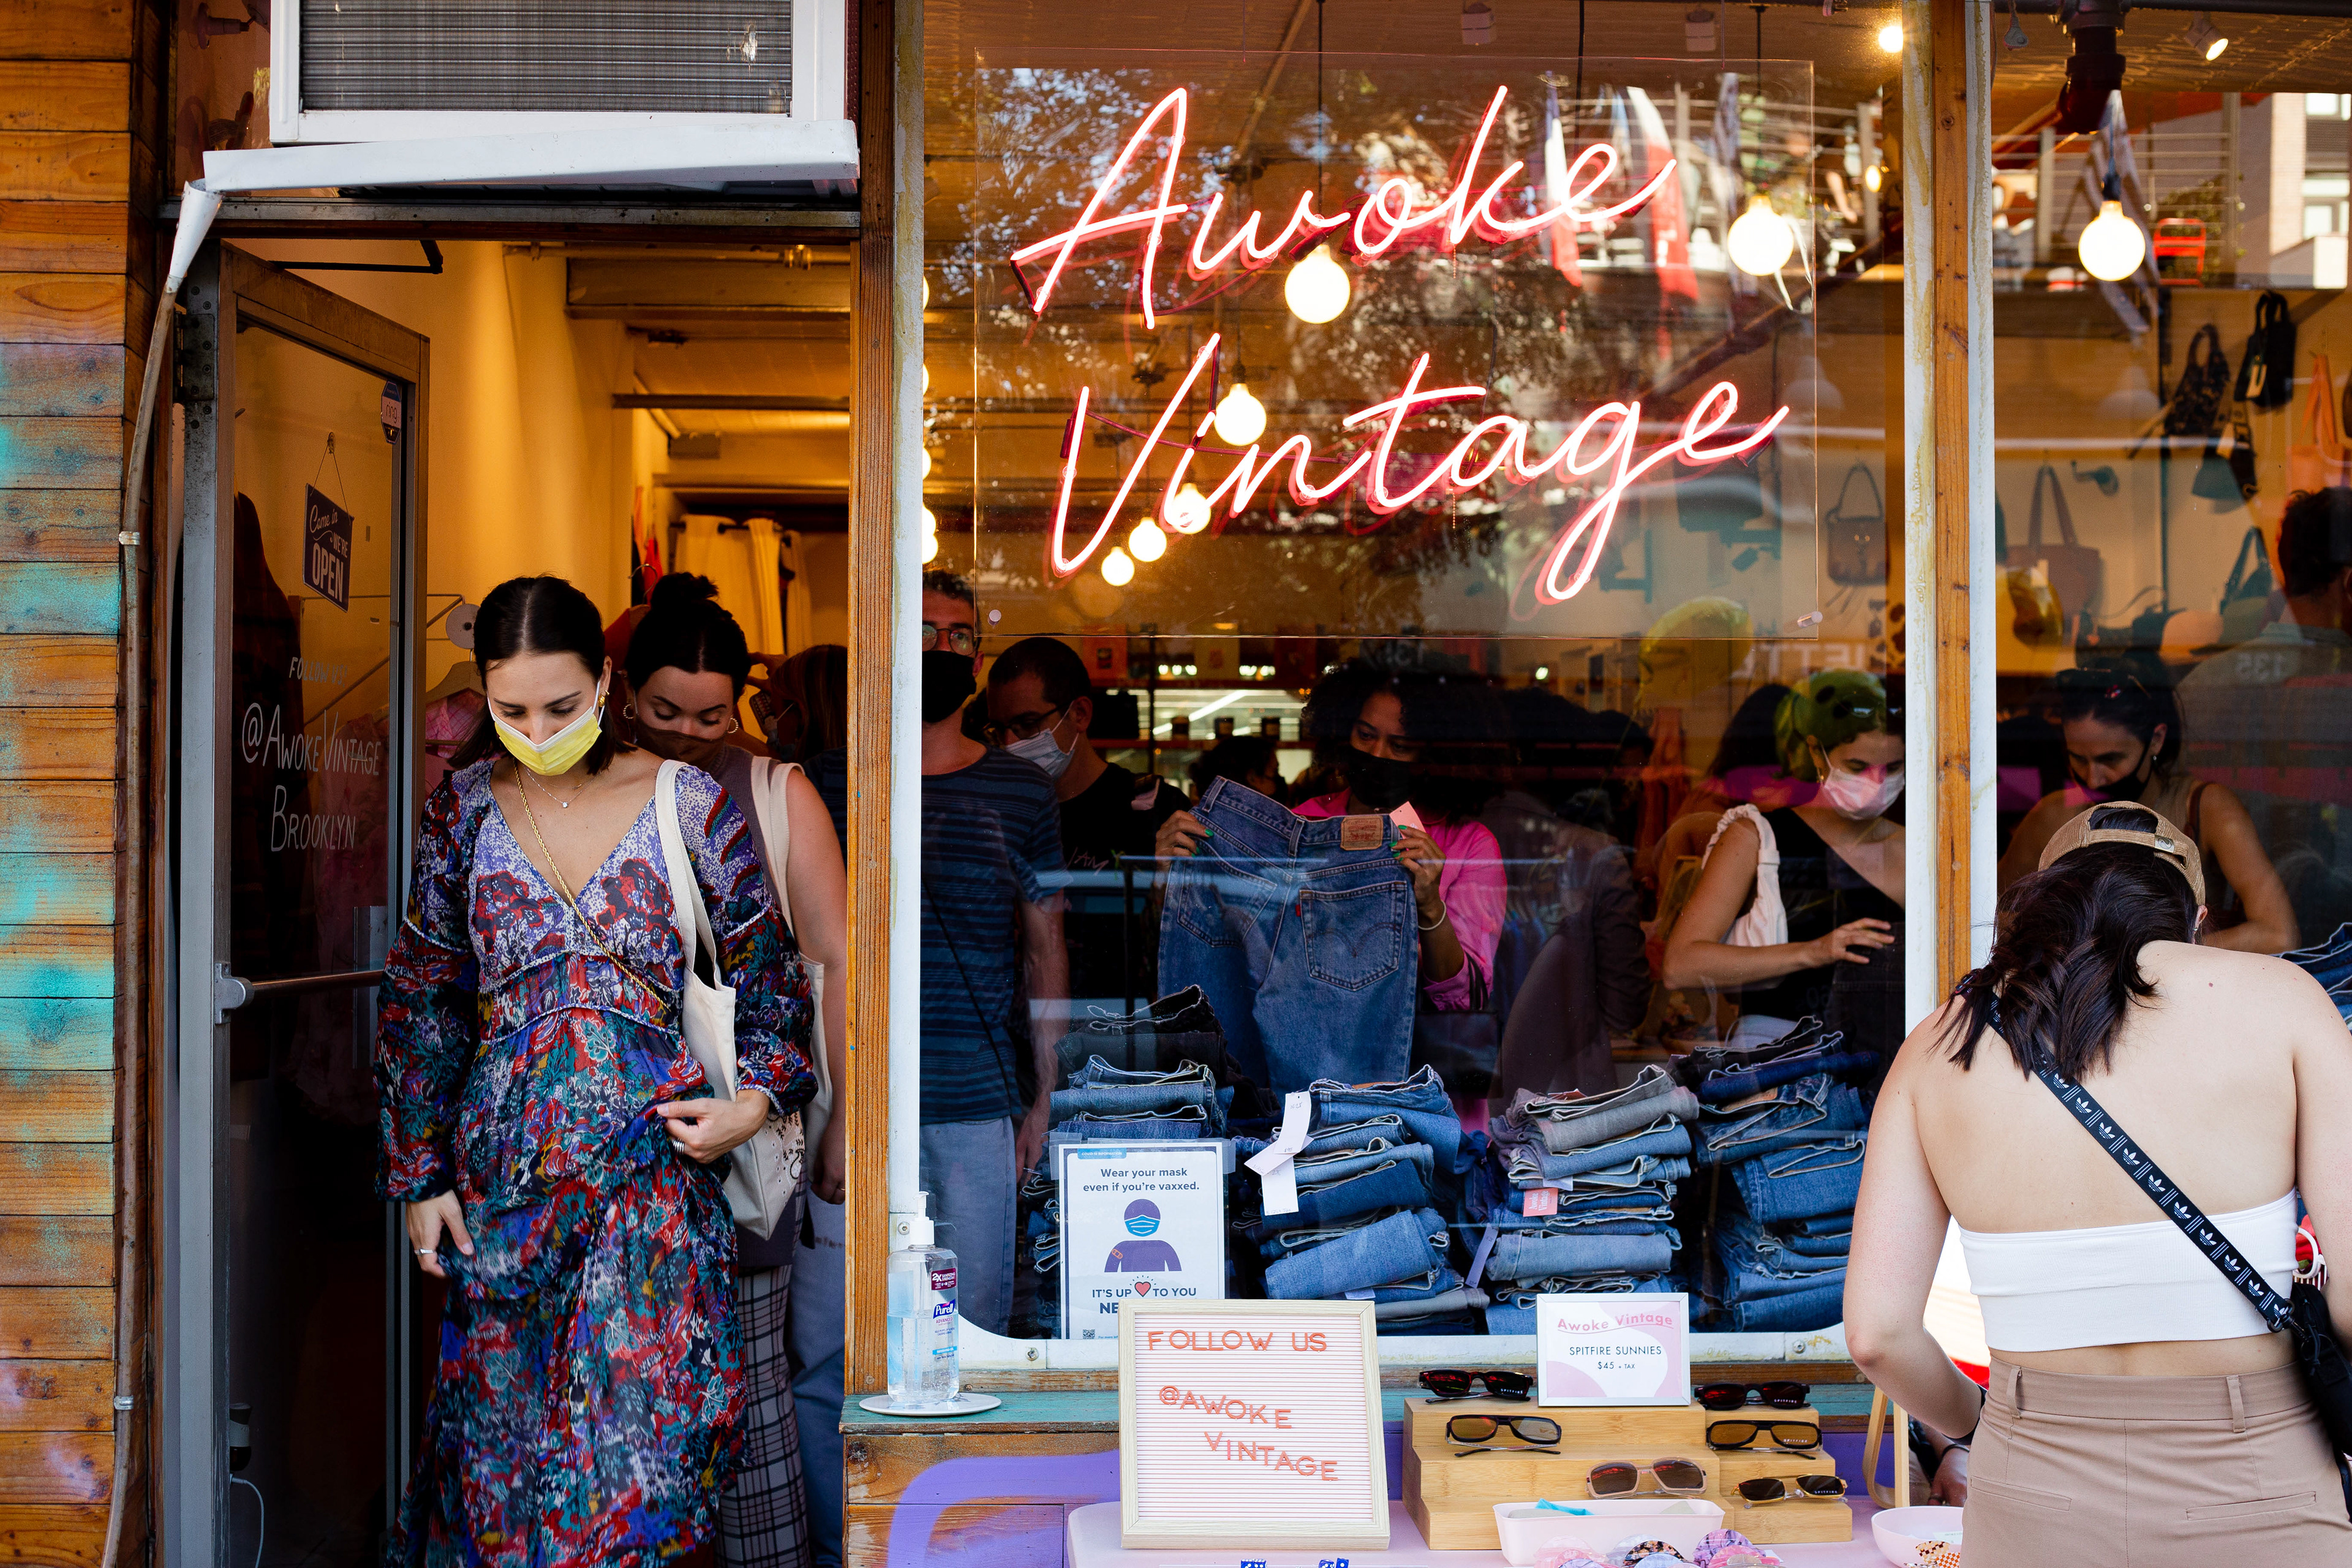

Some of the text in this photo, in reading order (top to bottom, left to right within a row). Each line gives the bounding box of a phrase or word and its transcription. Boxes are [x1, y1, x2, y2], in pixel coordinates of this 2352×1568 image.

[1011, 85, 1677, 330] Awoke
[386, 401, 398, 424] ring
[1050, 333, 1790, 602] Vintage
[309, 504, 338, 533] Come in
[333, 531, 349, 559] WE'RE
[312, 541, 344, 603] OPEN
[289, 657, 328, 684] FOLLOW
[271, 785, 356, 853] BROOKLYN
[1101, 1167, 1188, 1180] Wear your mask
[1112, 1182, 1120, 1191] if
[1121, 1182, 1156, 1194] you're
[1158, 1181, 1199, 1191] vaxxed.
[932, 1272, 942, 1282] 2X
[1092, 1287, 1197, 1298] IT'S UP TO YOU
[1558, 1313, 1673, 1332] Awoke Vintage
[1147, 1330, 1327, 1352] FOLLOW US
[1569, 1346, 1662, 1356] SPITFIRE SUNNIES
[1597, 1361, 1615, 1370] $45
[1159, 1385, 1292, 1430] @AWOKE
[1204, 1431, 1339, 1482] VINTAGE
